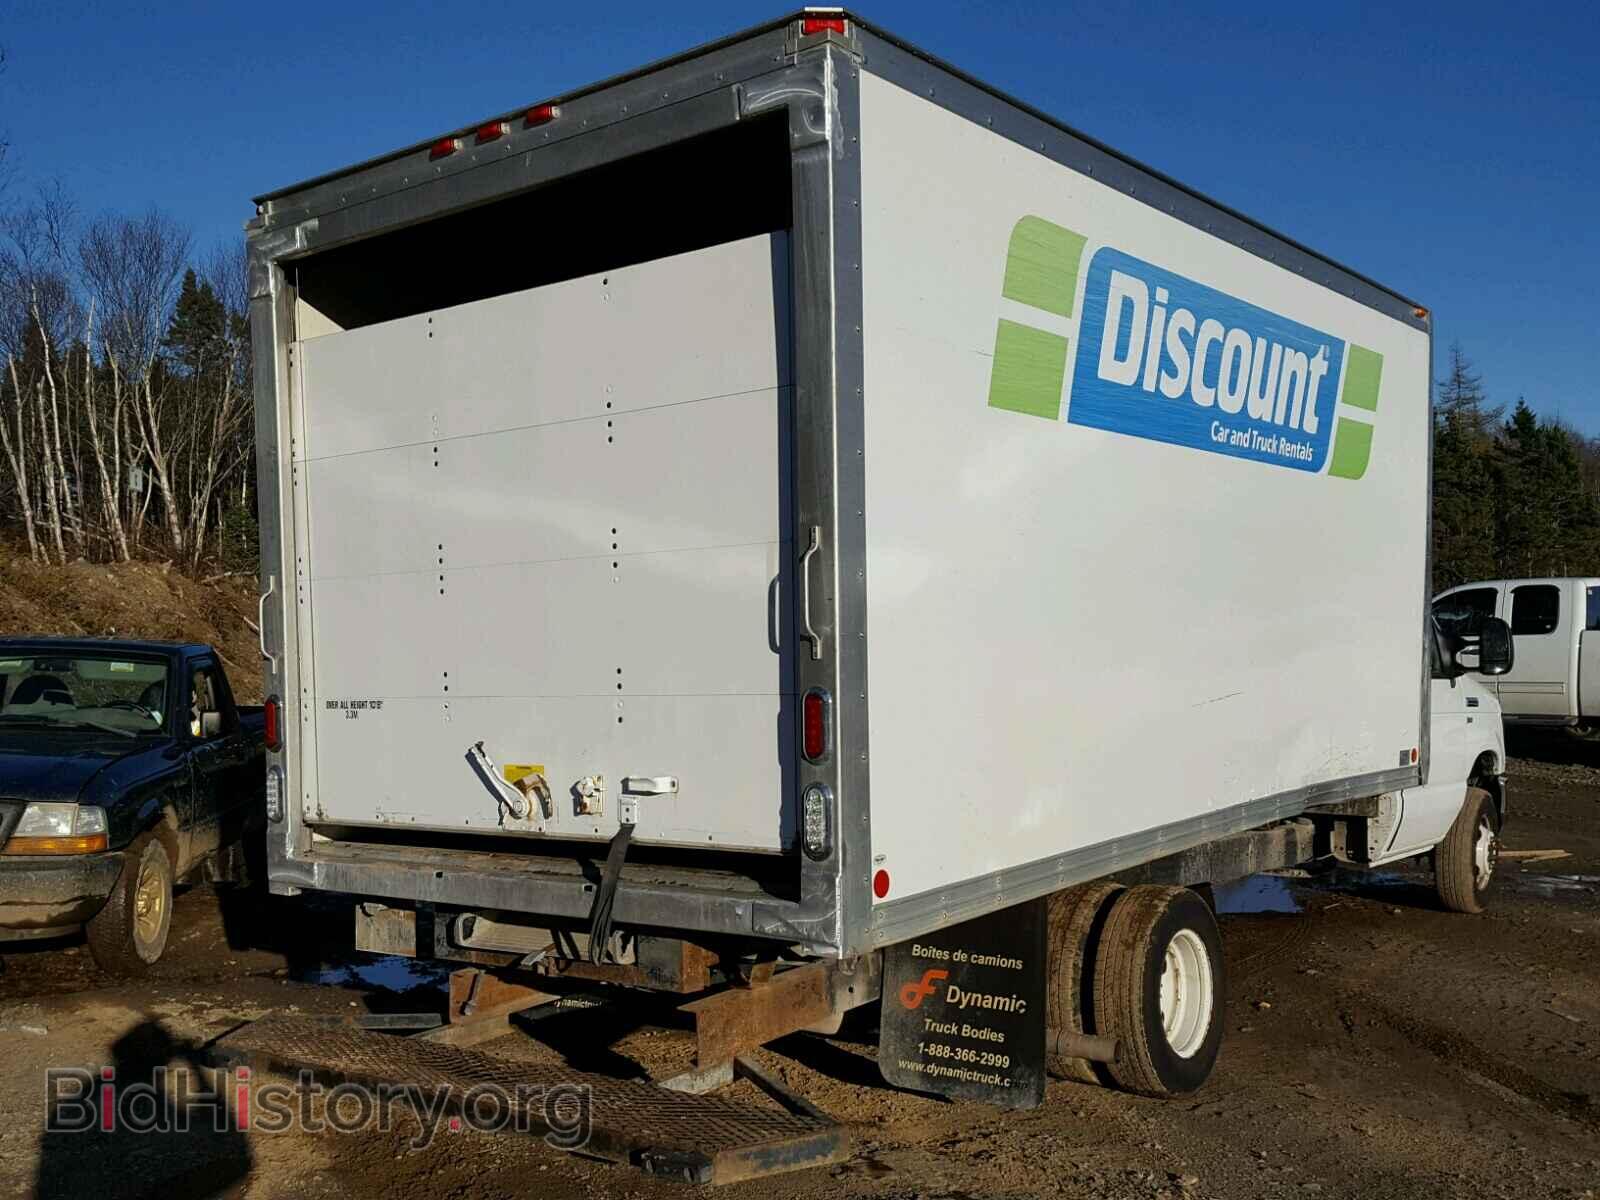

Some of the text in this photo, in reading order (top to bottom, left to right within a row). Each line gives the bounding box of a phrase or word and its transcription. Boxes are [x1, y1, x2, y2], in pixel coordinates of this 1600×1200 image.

[1097, 269, 1329, 434] Discount
[1211, 420, 1313, 461] Car and Truck Rentals
[952, 949, 969, 962] de
[970, 954, 1024, 971] camions
[946, 984, 1027, 1014] Dynamic
[924, 1018, 1005, 1043] Truck Bodies
[917, 1042, 1010, 1069] 1-888-366-2999
[898, 1058, 1027, 1088] www.dynamictruck.c
